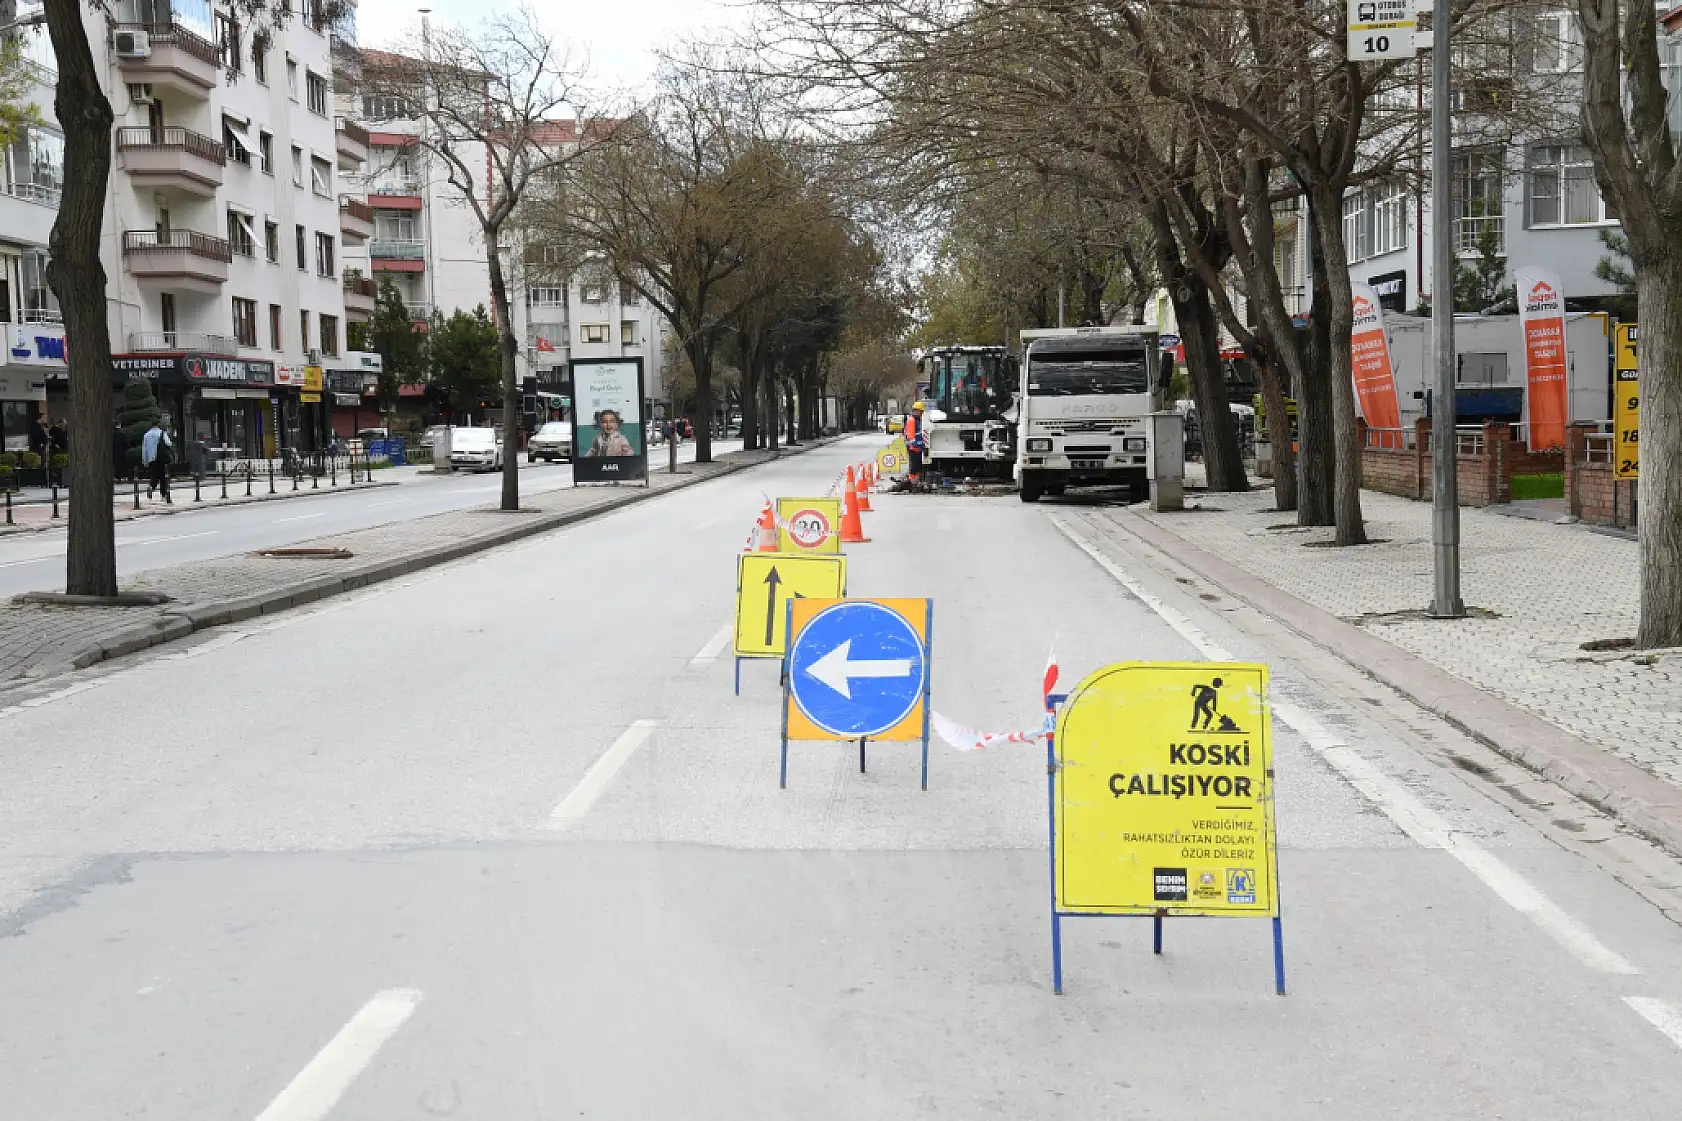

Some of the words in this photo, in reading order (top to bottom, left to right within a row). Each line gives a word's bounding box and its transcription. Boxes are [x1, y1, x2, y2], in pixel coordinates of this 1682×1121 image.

[1364, 35, 1389, 53] 10
[112, 359, 175, 370] VETERİNER
[1627, 397, 1638, 410] 9
[1169, 740, 1250, 766] KOSKİ
[1109, 773, 1251, 799] ÇALIŞIYOR
[1123, 833, 1212, 844] RAHATSIZLIKTAN
[1215, 834, 1255, 845] DOLAYI
[1181, 846, 1211, 858] ÖZÜR
[1214, 848, 1255, 859] DİLERİZ
